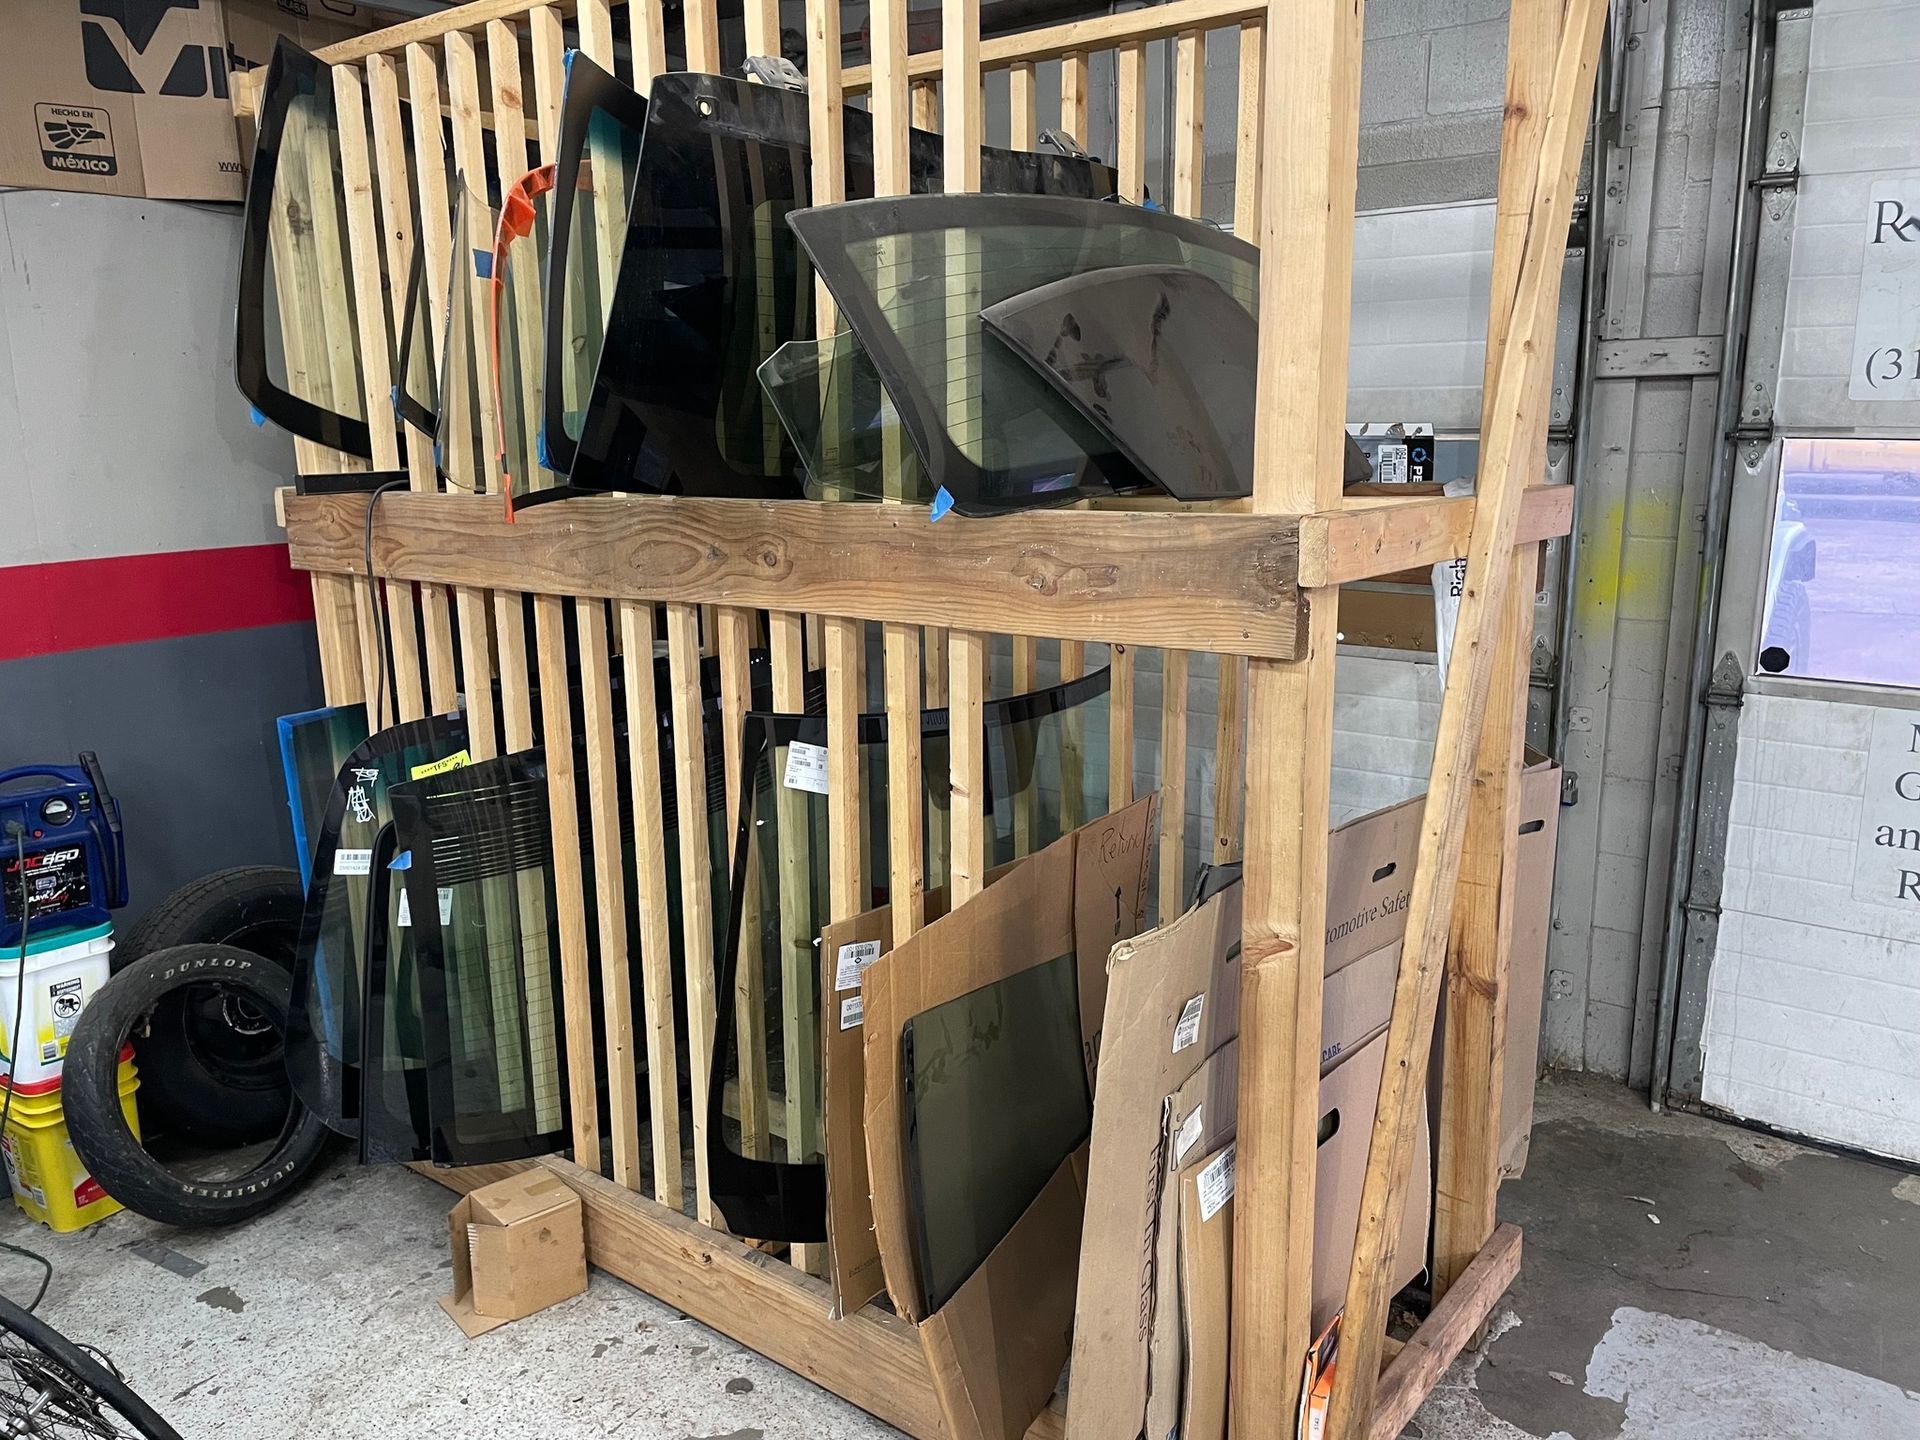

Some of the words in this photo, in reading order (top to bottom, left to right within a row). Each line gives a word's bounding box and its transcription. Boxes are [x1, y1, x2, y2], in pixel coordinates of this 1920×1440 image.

[51, 108, 79, 117] HECHO
[82, 111, 93, 119] EN
[164, 958, 252, 980] DUNLOP
[183, 1161, 295, 1198] QUALIFIER
